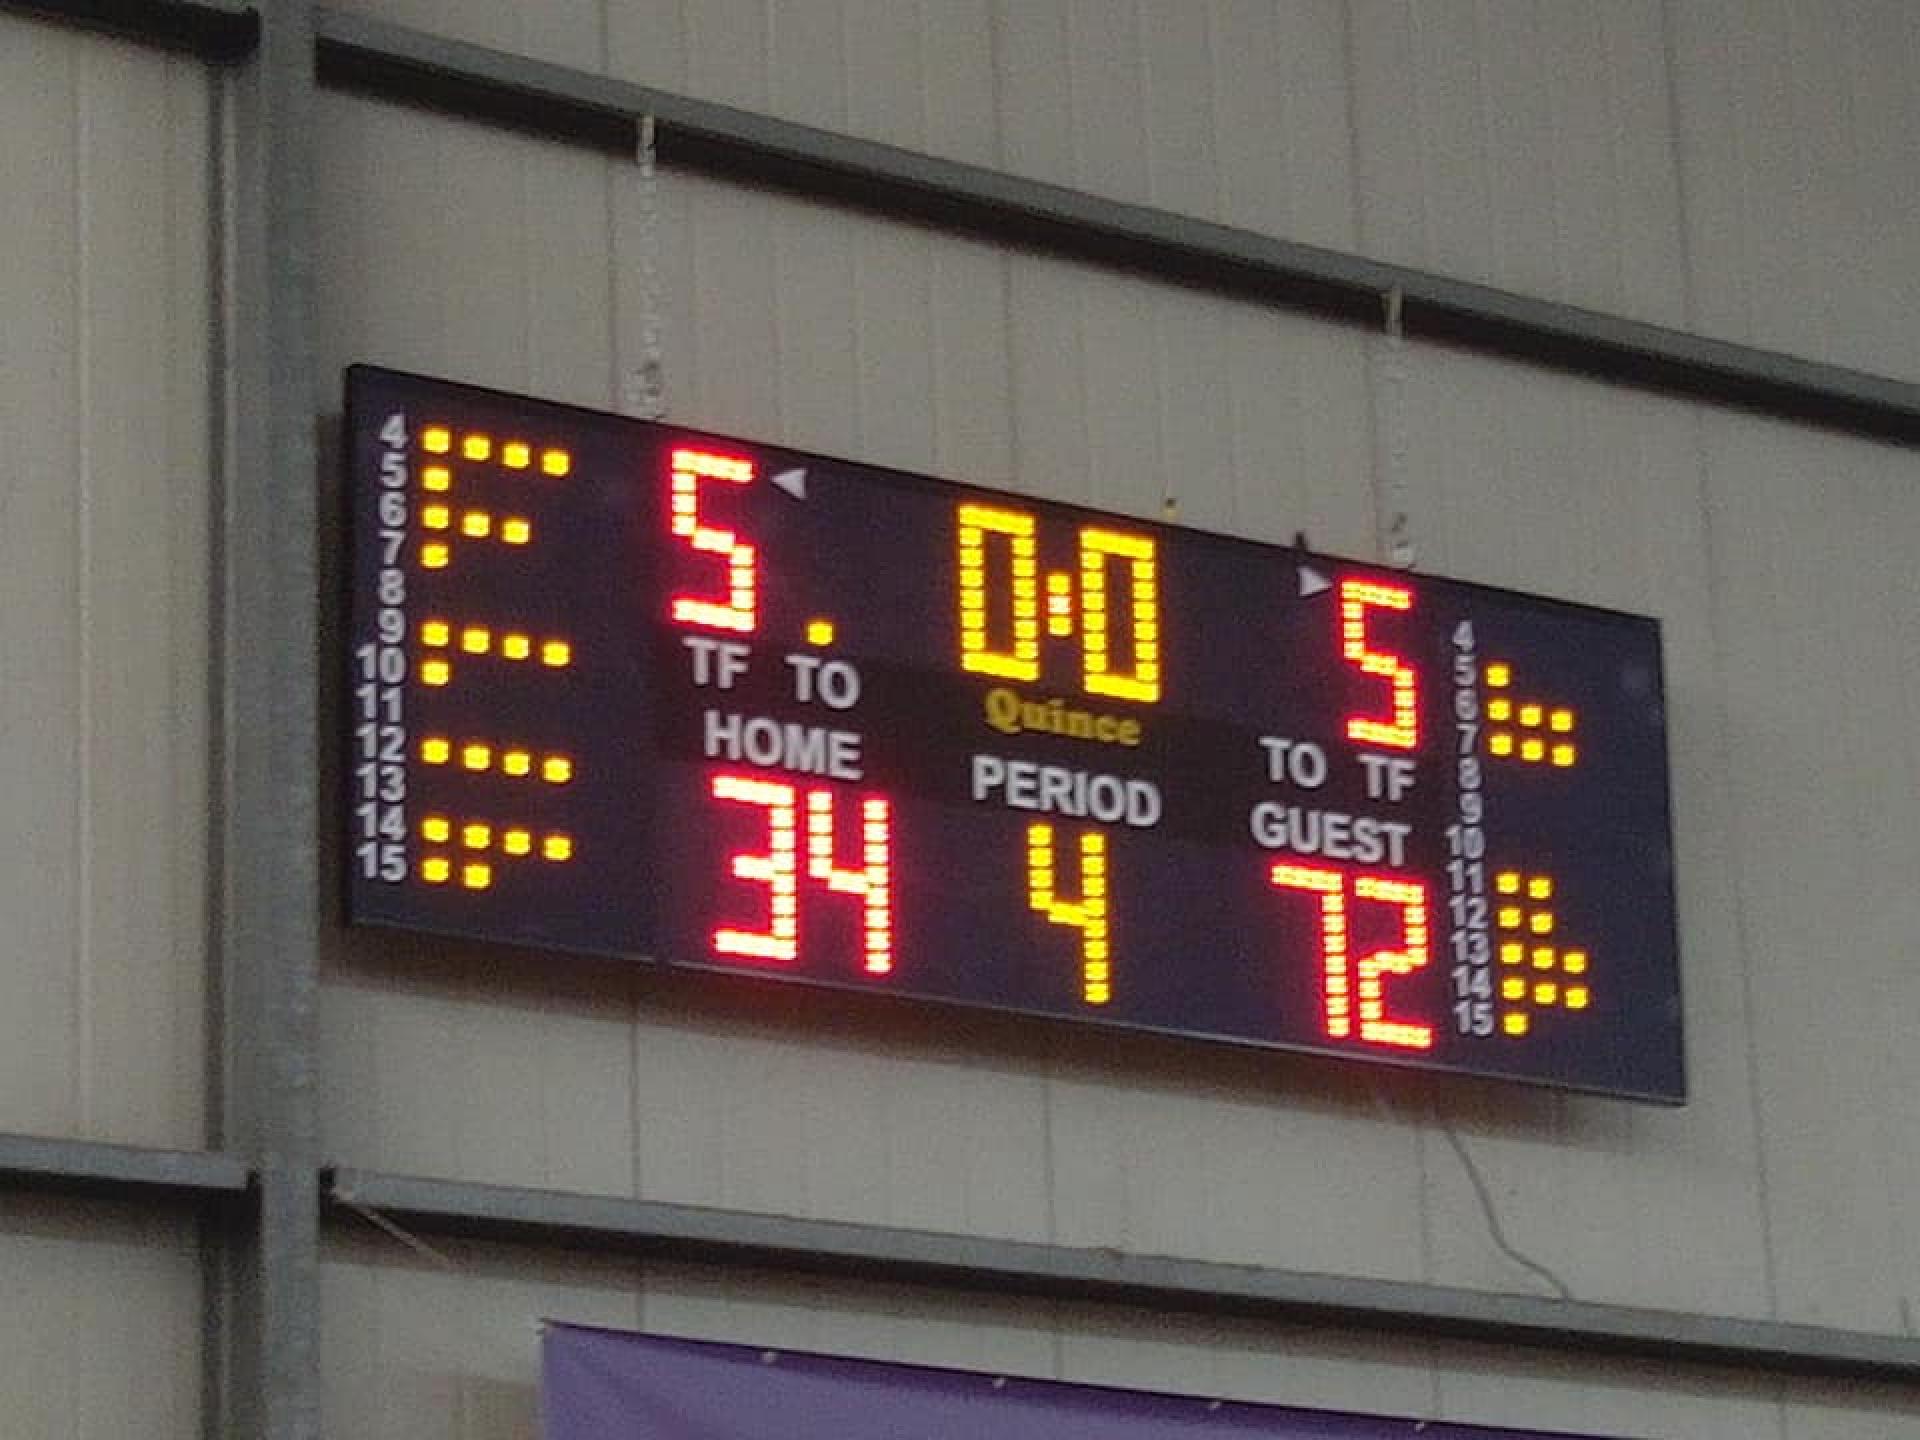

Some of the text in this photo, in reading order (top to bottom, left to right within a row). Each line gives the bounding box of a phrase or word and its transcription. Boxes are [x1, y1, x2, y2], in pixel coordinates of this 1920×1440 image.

[380, 414, 407, 449] 4
[380, 452, 406, 488] 5
[379, 491, 406, 527] 6
[378, 529, 405, 565] 7
[671, 449, 755, 631] 5
[379, 568, 405, 604] 8
[379, 607, 404, 643] 9
[1453, 620, 1474, 652] 4
[356, 643, 405, 683] 10
[684, 636, 861, 710] TF TO
[1341, 580, 1417, 748] 5
[1455, 656, 1476, 686] 5
[356, 683, 402, 722] 11
[984, 687, 1142, 746] Quince
[1456, 689, 1478, 721] 6
[356, 722, 405, 761] 12
[704, 709, 865, 782] HOME
[1456, 723, 1479, 754] 7
[356, 762, 406, 801] 13
[1259, 736, 1416, 802] TO TF
[1458, 757, 1482, 789] 8
[971, 754, 1162, 827] PERIOD
[1460, 792, 1483, 824] 9
[356, 802, 406, 841] 14
[1250, 803, 1412, 867] GUEST
[1446, 825, 1485, 859] 10
[356, 841, 407, 882] 15
[712, 775, 893, 973] 34
[1447, 859, 1484, 893] 11
[1027, 822, 1110, 1004] 4
[1449, 894, 1488, 930] 12
[1270, 864, 1431, 1050] 72
[1451, 929, 1490, 965] 13
[1453, 965, 1491, 1000] 14
[1455, 1000, 1494, 1036] 15
